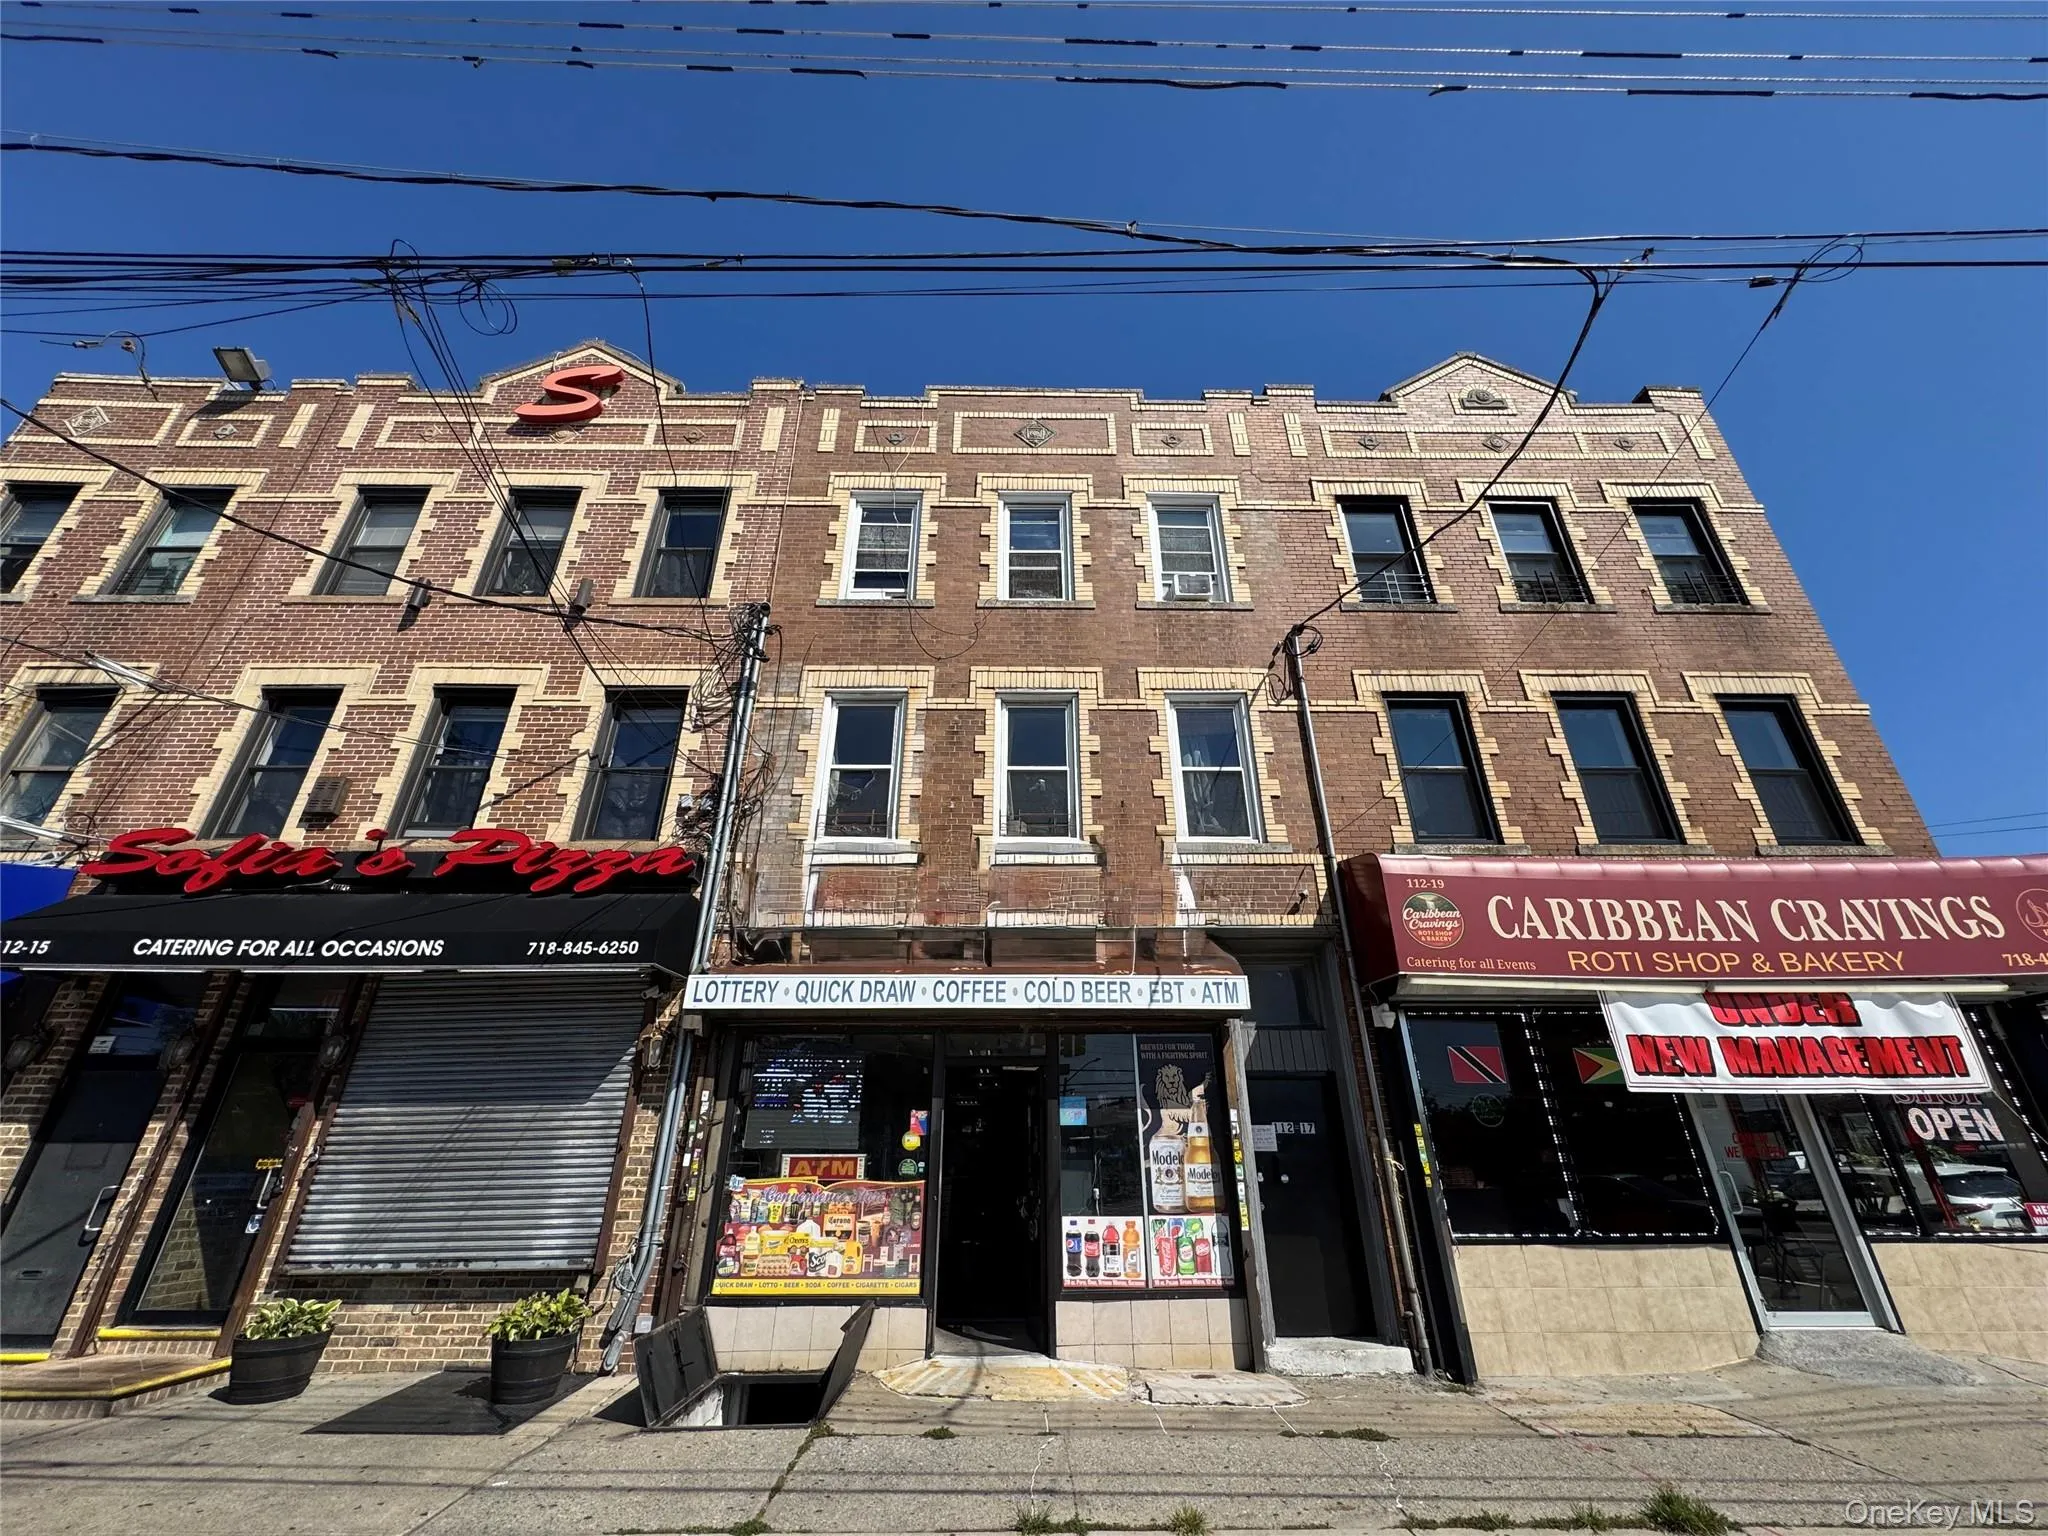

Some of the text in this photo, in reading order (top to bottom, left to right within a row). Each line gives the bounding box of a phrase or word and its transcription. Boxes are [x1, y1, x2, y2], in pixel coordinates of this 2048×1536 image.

[513, 365, 625, 423] S
[433, 828, 697, 893] Pizza
[1406, 878, 1445, 889] 112-19
[1403, 907, 1461, 920] Caribbean
[1487, 895, 1761, 943] CARIBBEAN
[1770, 895, 2006, 942] CRAVINGS
[1409, 919, 1460, 931] Cravings
[0, 940, 52, 955] 12-15
[133, 938, 445, 957] CATERING FOR ALL OCCASIONS
[526, 941, 639, 955] 718-845-6250
[1406, 956, 1537, 971] Catering for all Events
[1568, 951, 1905, 974] ROTI SHOP & BAKERY
[2001, 952, 2048, 967] 718-4
[693, 980, 1240, 1004] LOTTERY QUICK DRAW COFFEE COLD BEER EBT ATM
[1703, 992, 1863, 1027] UNDER
[1141, 1051, 1156, 1060] WITH
[1625, 1034, 1971, 1079] NEW MANAGEMENT
[1907, 1107, 2005, 1142] OPEN
[792, 1160, 854, 1176] ATM
[2032, 1205, 2048, 1215] HE
[2033, 1217, 2048, 1225] WA
[809, 1254, 826, 1268] Sco
